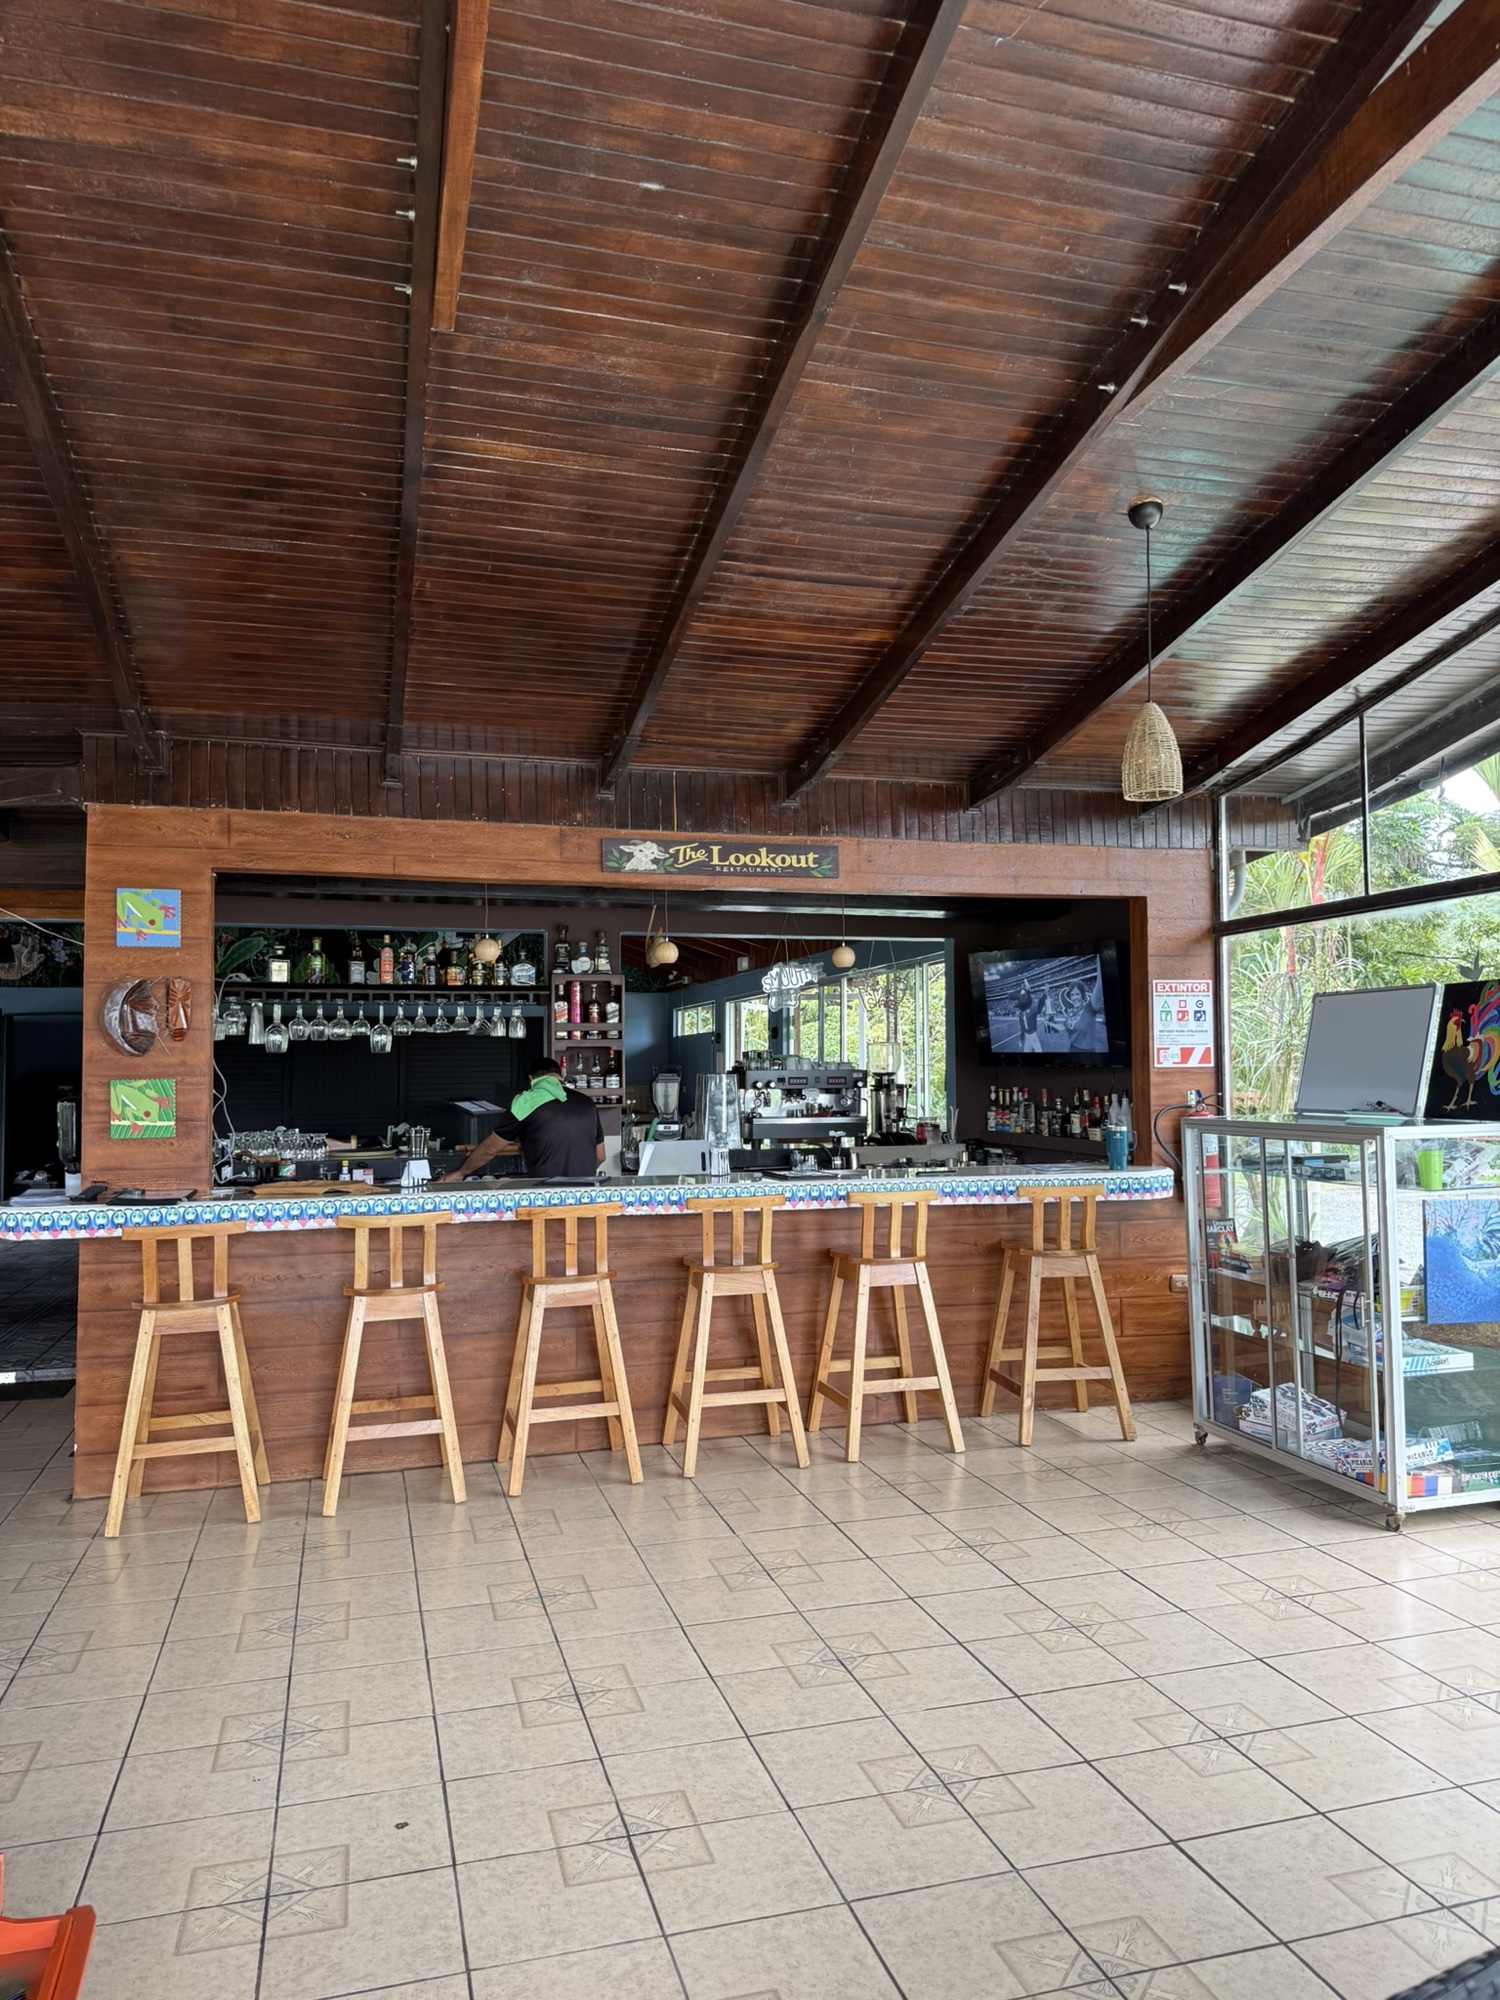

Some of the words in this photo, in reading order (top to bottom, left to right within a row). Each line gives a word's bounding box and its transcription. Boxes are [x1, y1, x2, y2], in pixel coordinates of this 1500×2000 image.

[669, 842, 708, 868] The
[710, 845, 819, 868] Lookout
[715, 866, 782, 874] RESTAURANT
[1157, 983, 1208, 992] EXTINTOR
[1206, 1224, 1235, 1233] BARCLAY
